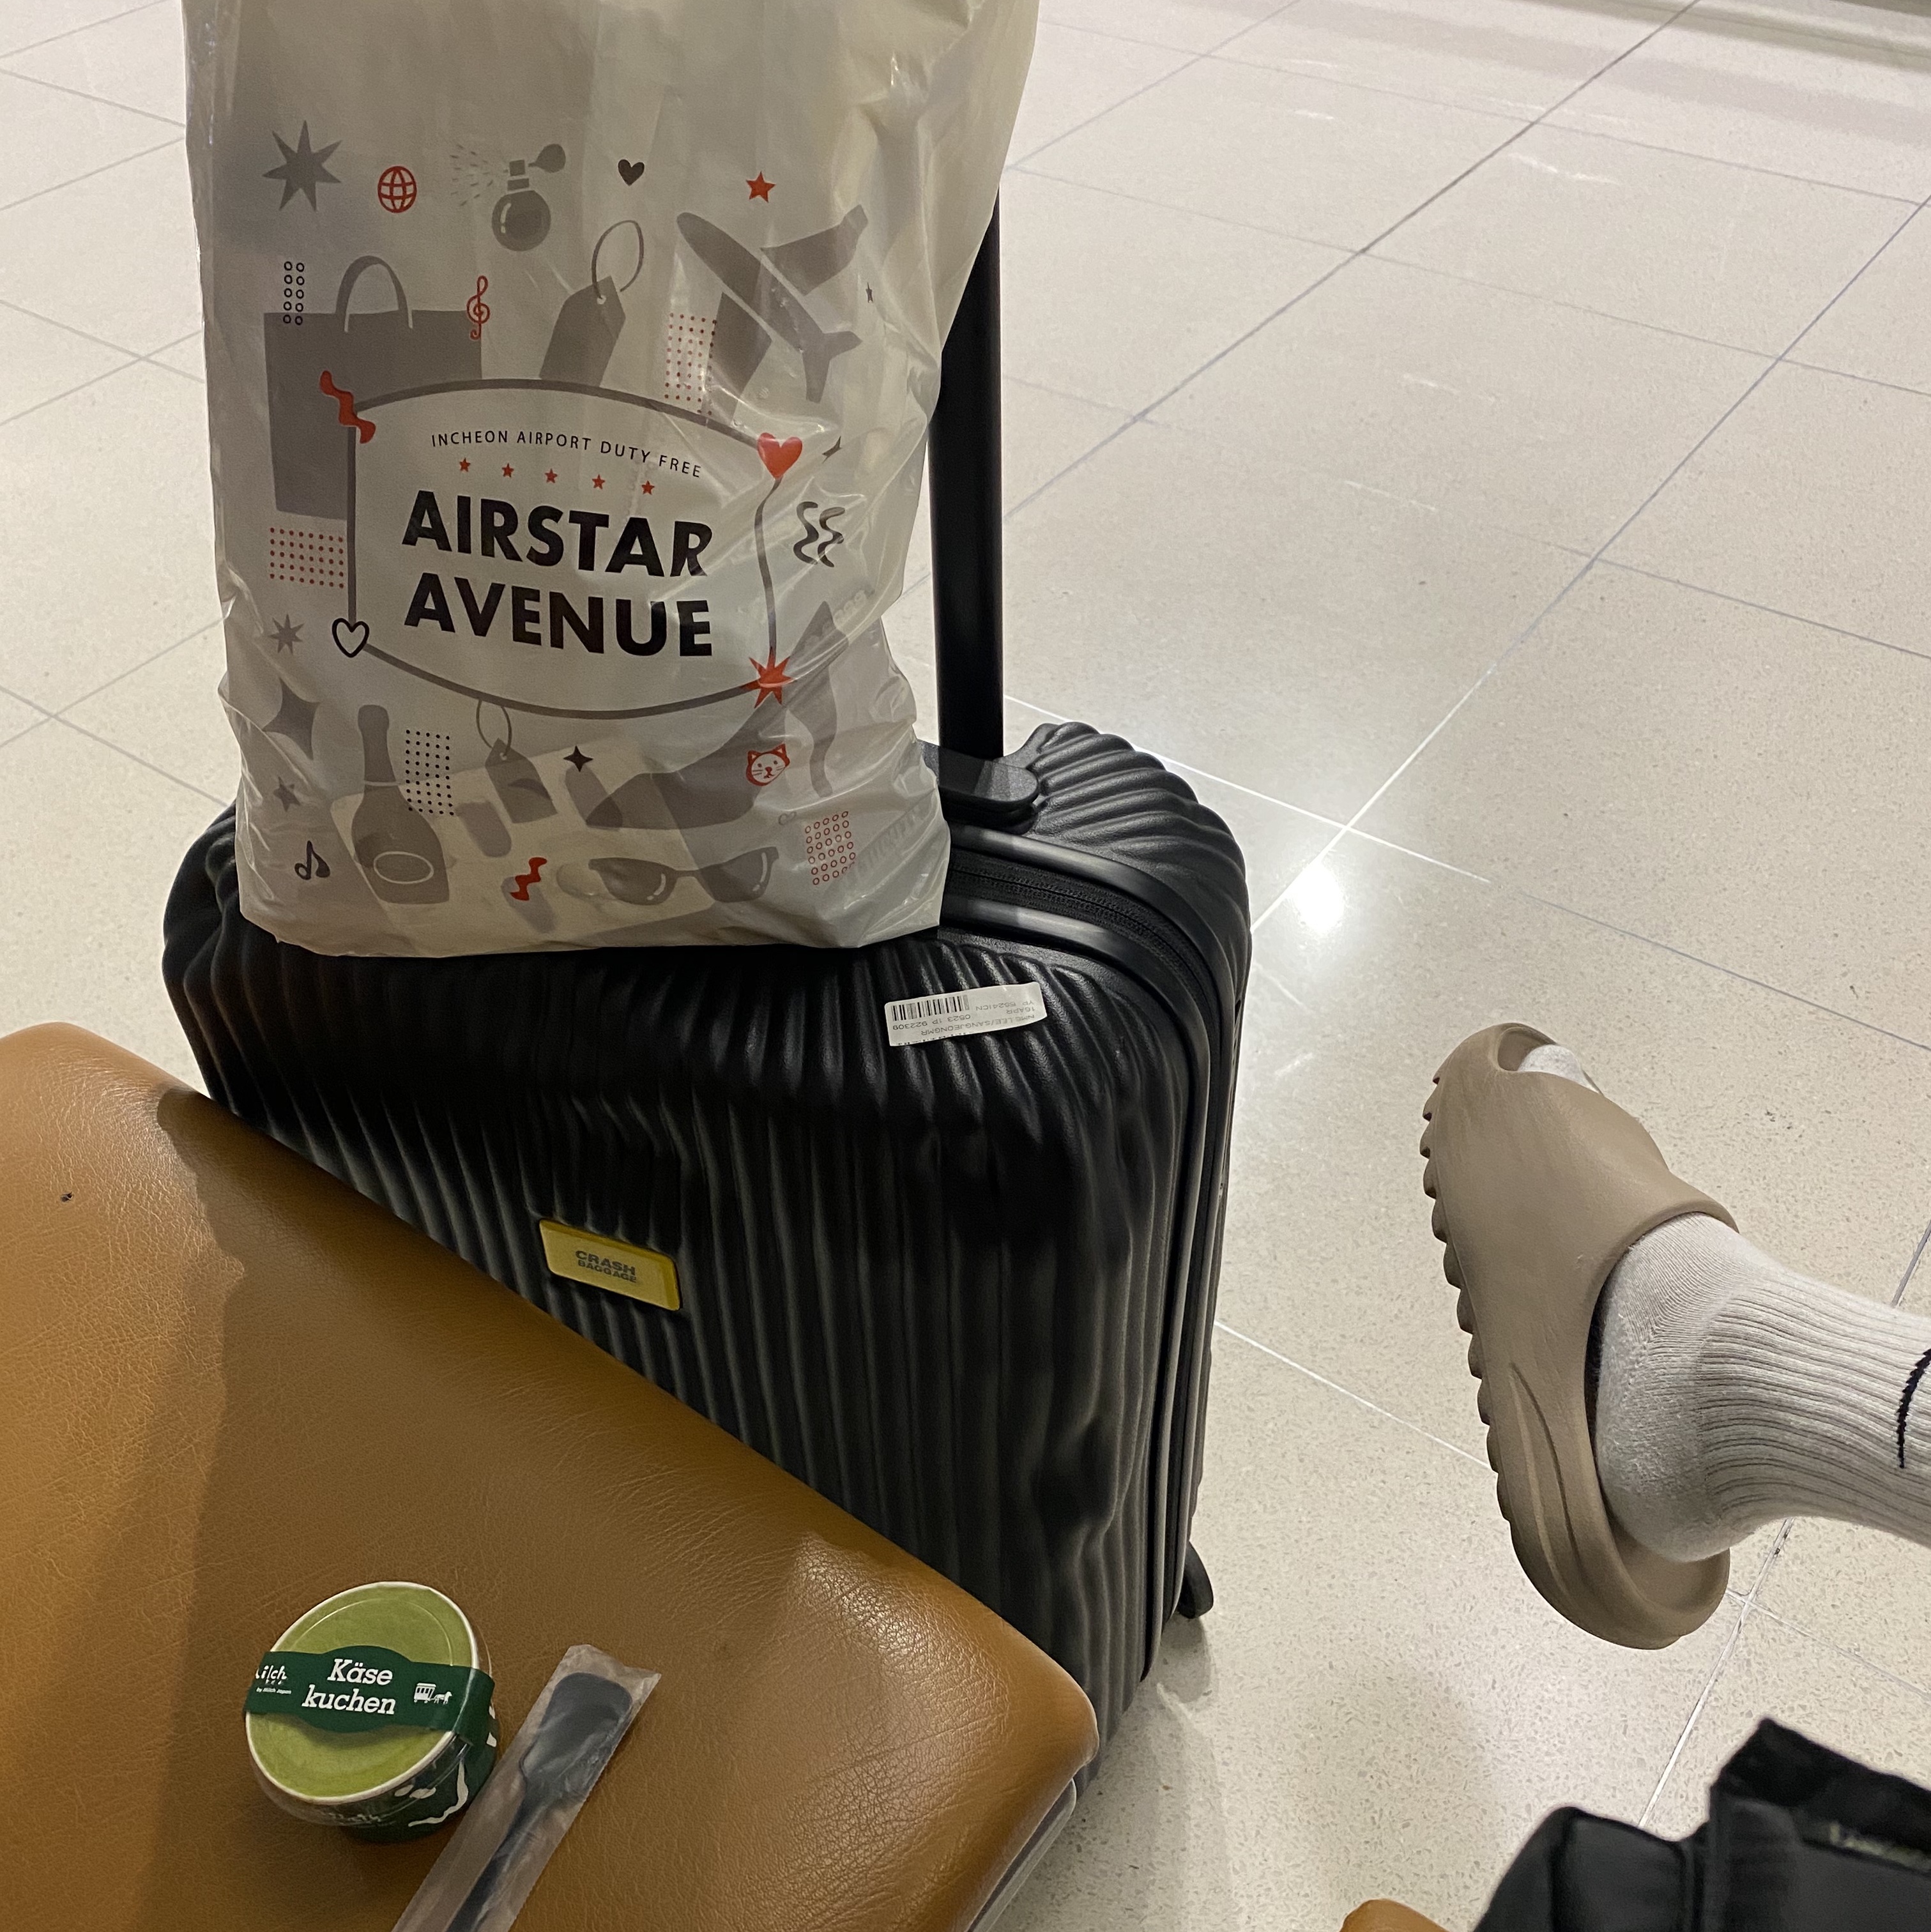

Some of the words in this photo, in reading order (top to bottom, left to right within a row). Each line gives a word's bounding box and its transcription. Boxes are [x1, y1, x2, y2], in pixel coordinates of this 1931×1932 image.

[432, 430, 508, 447] INCHEON
[516, 430, 592, 451] AIRPORT
[600, 440, 651, 464] DUTY
[659, 454, 702, 478] FREE
[402, 490, 713, 577] AIRSTAR
[404, 572, 712, 657] AVENUE
[575, 1250, 636, 1276] CRASH
[577, 1259, 637, 1284] BAGGAGE
[255, 1664, 287, 1680] ilch
[326, 1658, 393, 1686] Käse
[301, 1684, 396, 1715] kuchen
